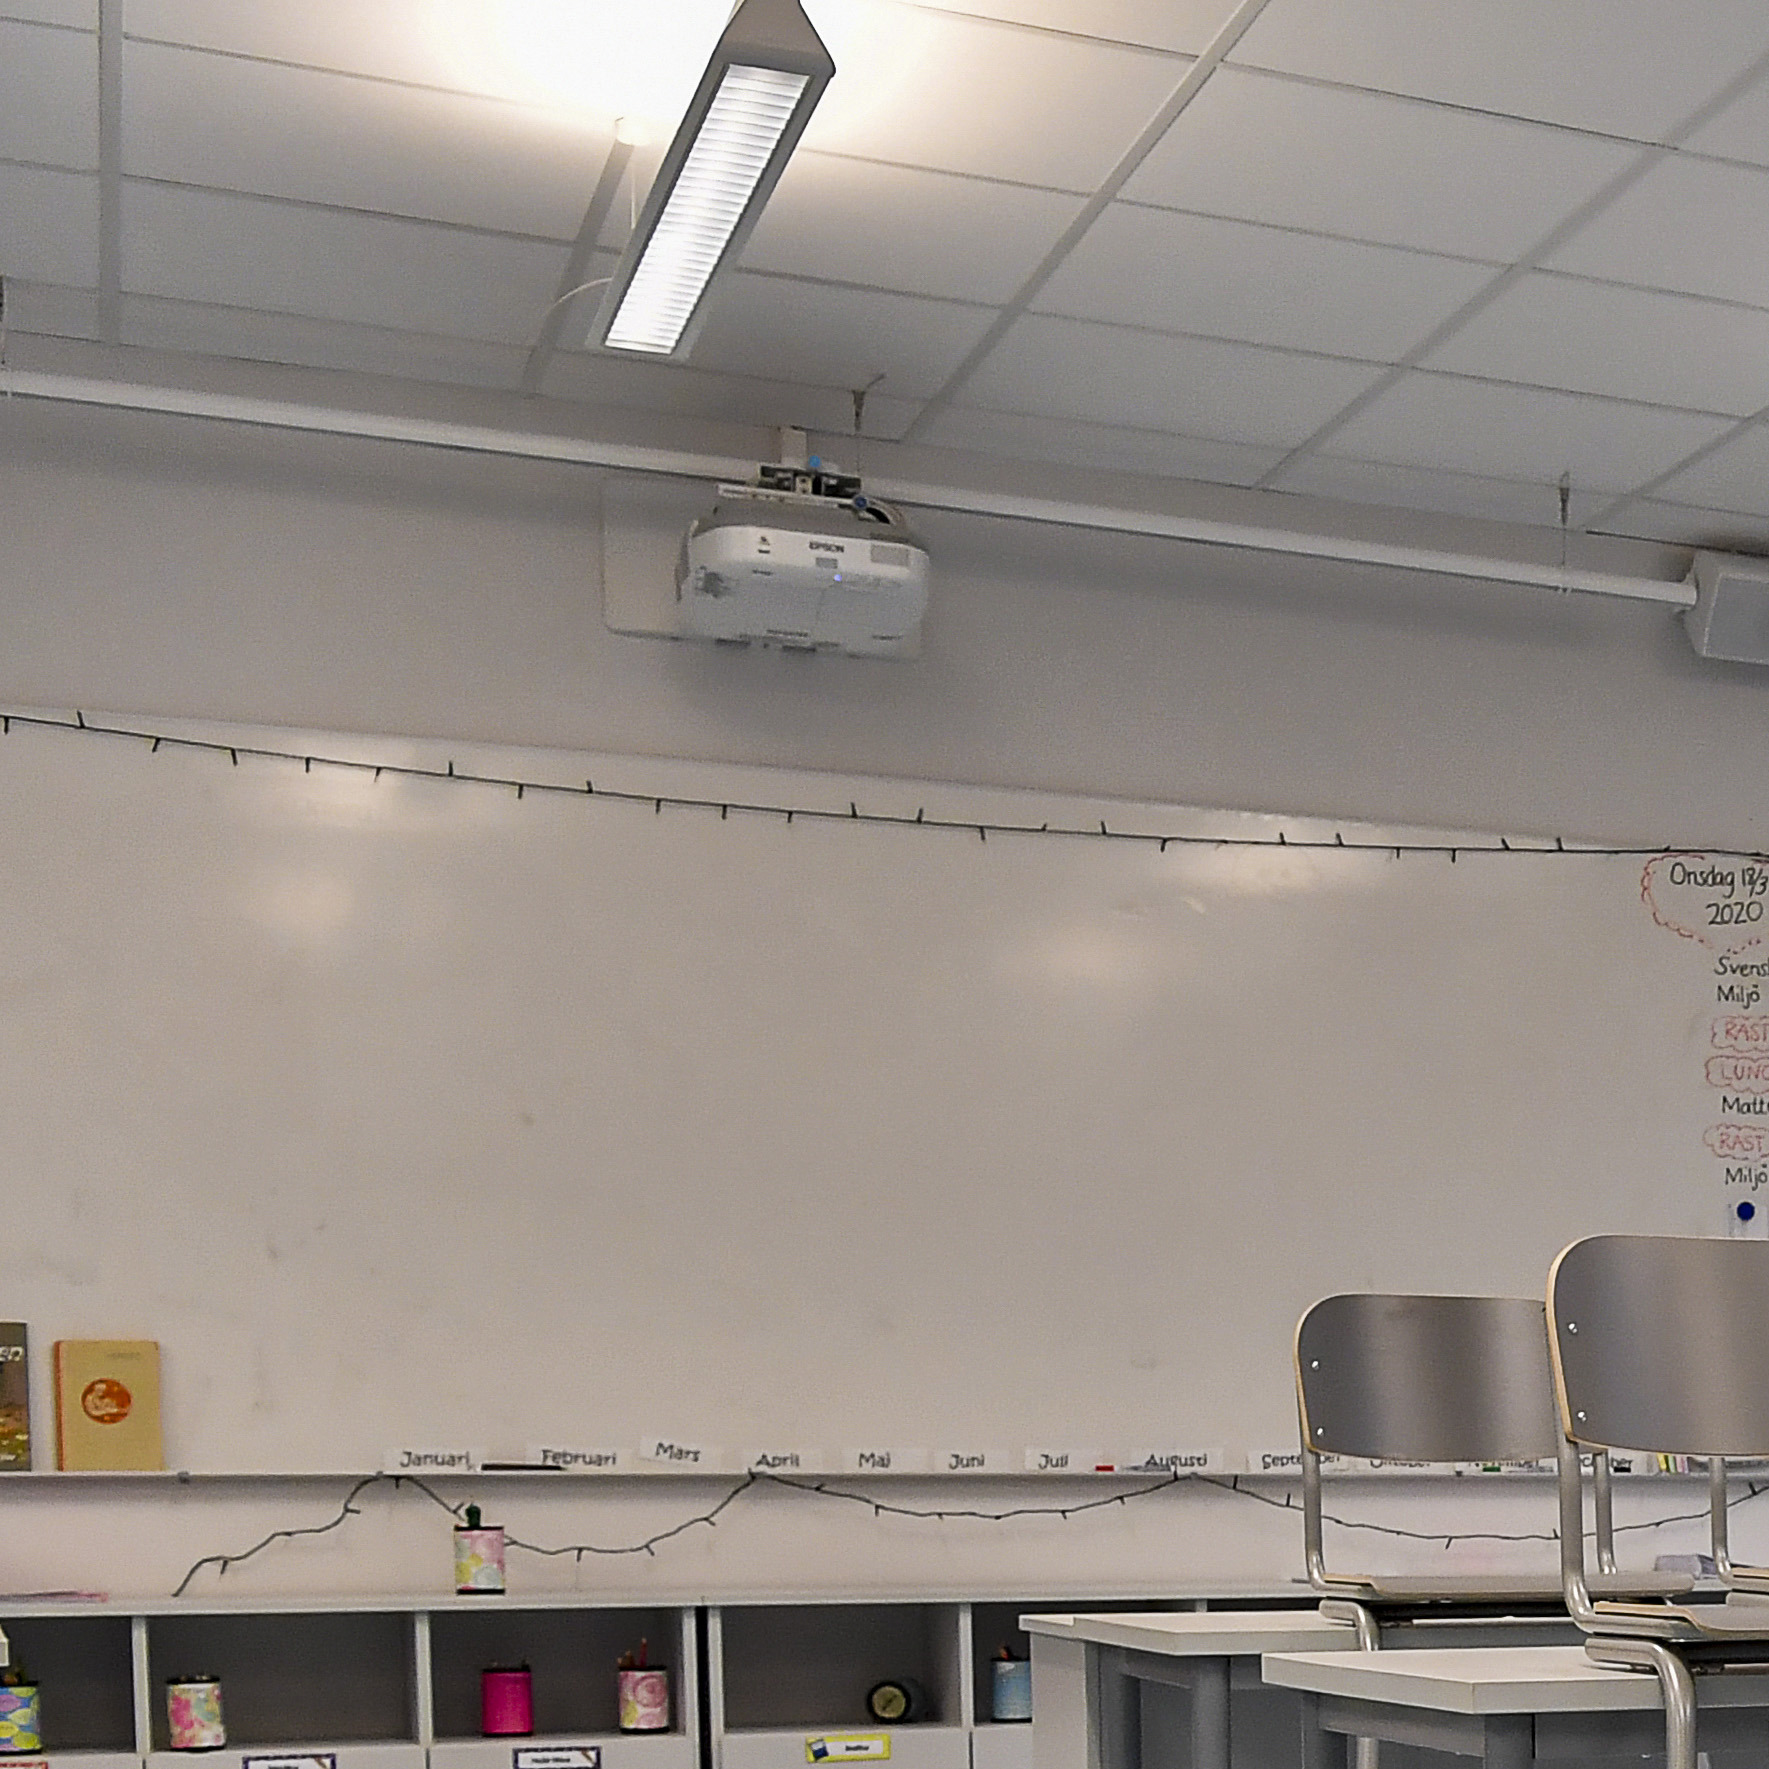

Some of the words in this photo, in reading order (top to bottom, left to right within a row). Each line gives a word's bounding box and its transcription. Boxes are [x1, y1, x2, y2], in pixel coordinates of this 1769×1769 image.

[1669, 862, 1735, 898] Onsdag
[1705, 901, 1763, 925] 2020
[1716, 984, 1761, 1009] Miljö
[1719, 1132, 1764, 1152] RAST
[1725, 1163, 1768, 1191] Miljö
[400, 1450, 470, 1468] Januari
[541, 1449, 616, 1466] Februari
[655, 1441, 701, 1463] Mars
[755, 1452, 800, 1468] April
[949, 1453, 985, 1469] Juni
[1145, 1453, 1207, 1470] Augusti
